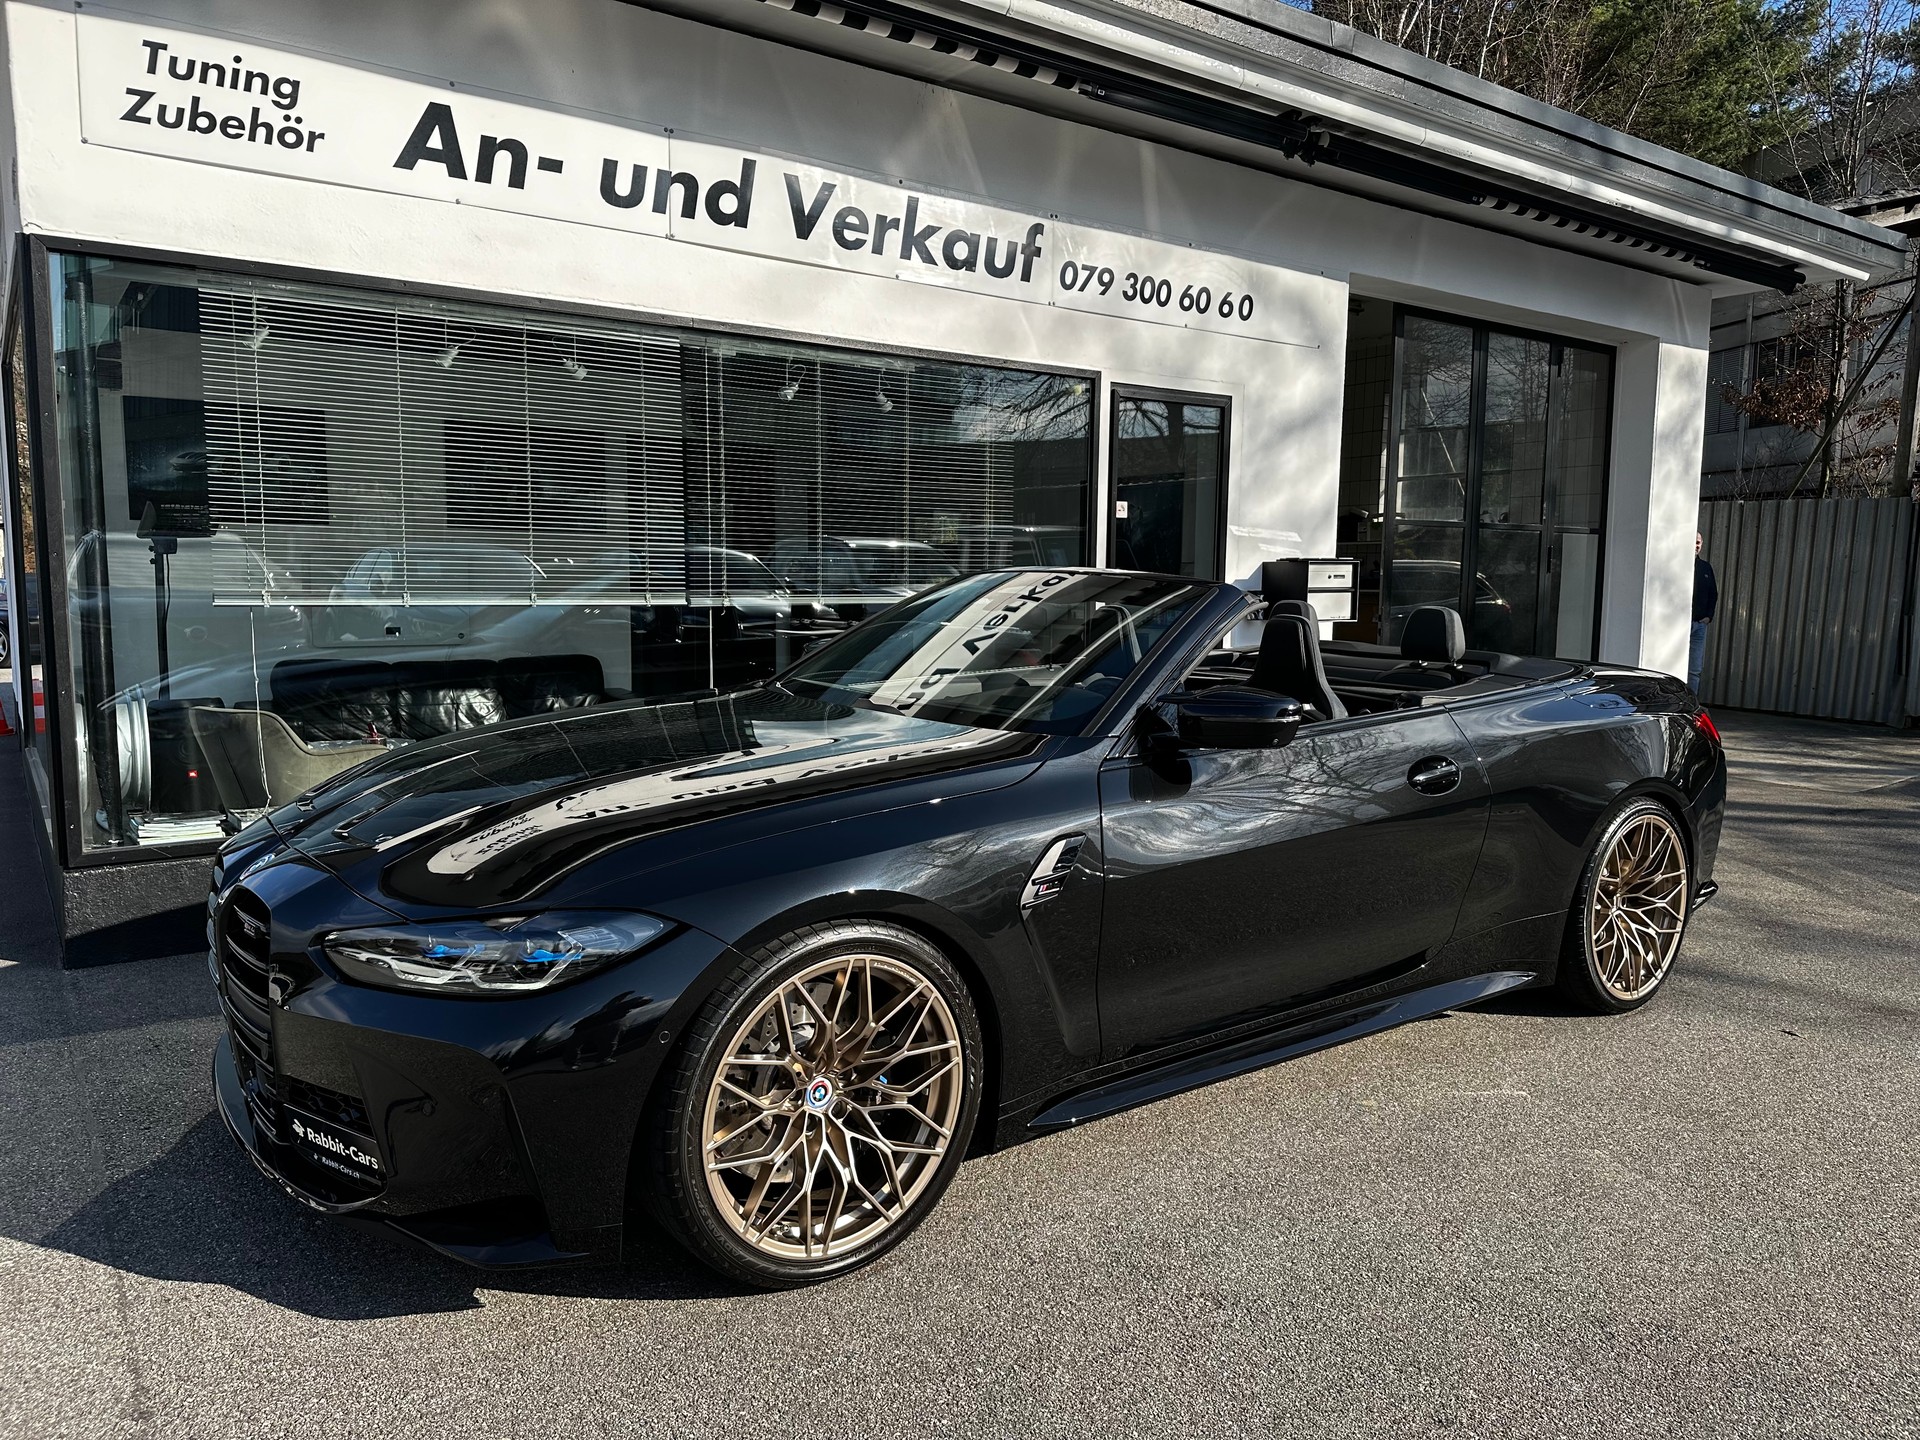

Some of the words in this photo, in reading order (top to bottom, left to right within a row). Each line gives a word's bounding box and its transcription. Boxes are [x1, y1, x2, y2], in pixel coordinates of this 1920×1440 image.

[142, 39, 301, 111] Tuning
[119, 87, 325, 153] Zubehör
[393, 101, 564, 191] An-
[600, 157, 756, 229] und
[783, 172, 1044, 283] Verkauf
[1059, 260, 1115, 296] 079
[1123, 272, 1171, 307] 300
[1179, 284, 1212, 315] 60
[1219, 291, 1254, 322] 60
[306, 1127, 379, 1169] Rabbit-Cars
[321, 1156, 360, 1179] Rabbit-Cars.ch
[705, 1217, 742, 1257] ADVAN
